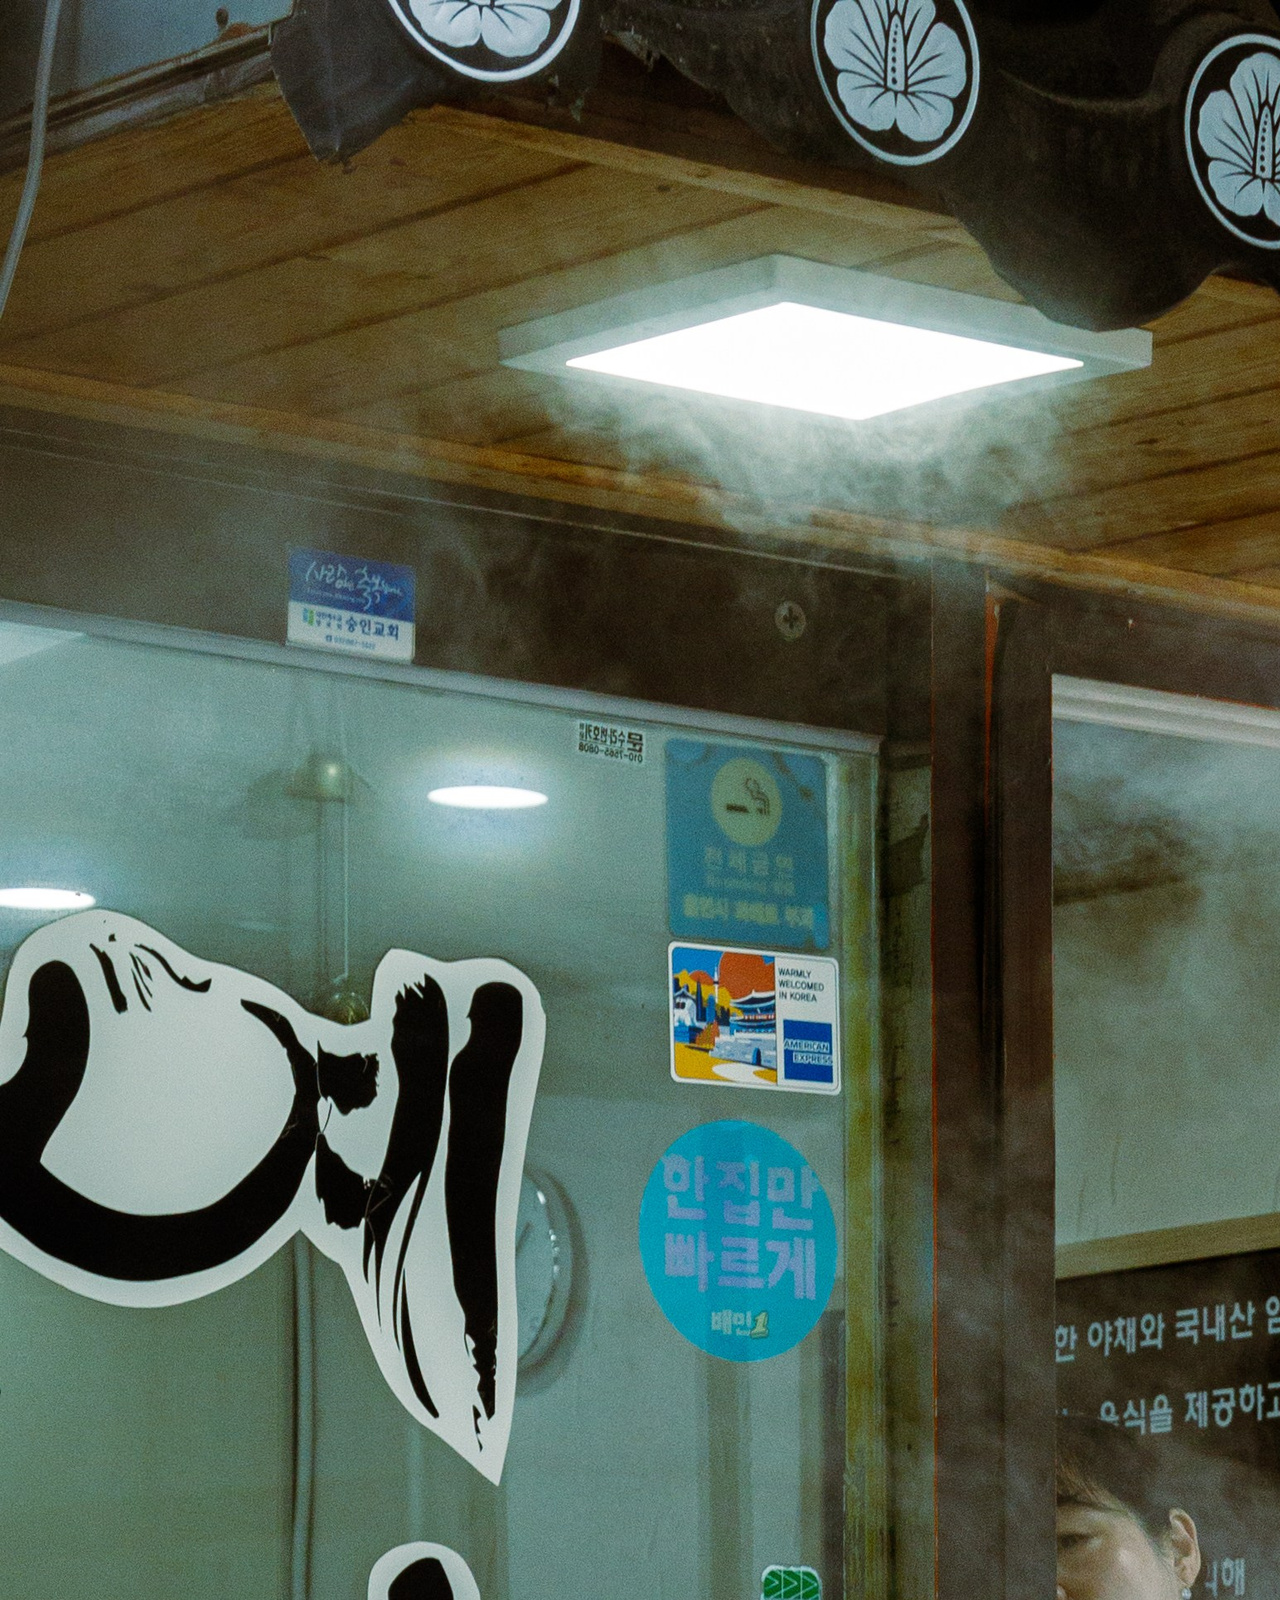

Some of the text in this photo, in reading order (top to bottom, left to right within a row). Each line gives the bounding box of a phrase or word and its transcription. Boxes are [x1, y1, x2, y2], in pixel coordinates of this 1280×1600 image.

[779, 967, 811, 979] WARMLY
[779, 979, 825, 992] WELCOMED
[790, 993, 817, 1003] KOREA
[784, 1039, 830, 1053] AMERICAN
[793, 1054, 833, 1066] EXPRESS
[662, 1153, 820, 1230] 한집만
[664, 1230, 817, 1300] 빠르게
[1087, 1312, 1165, 1357] 야채와
[1175, 1301, 1255, 1344] 국내산
